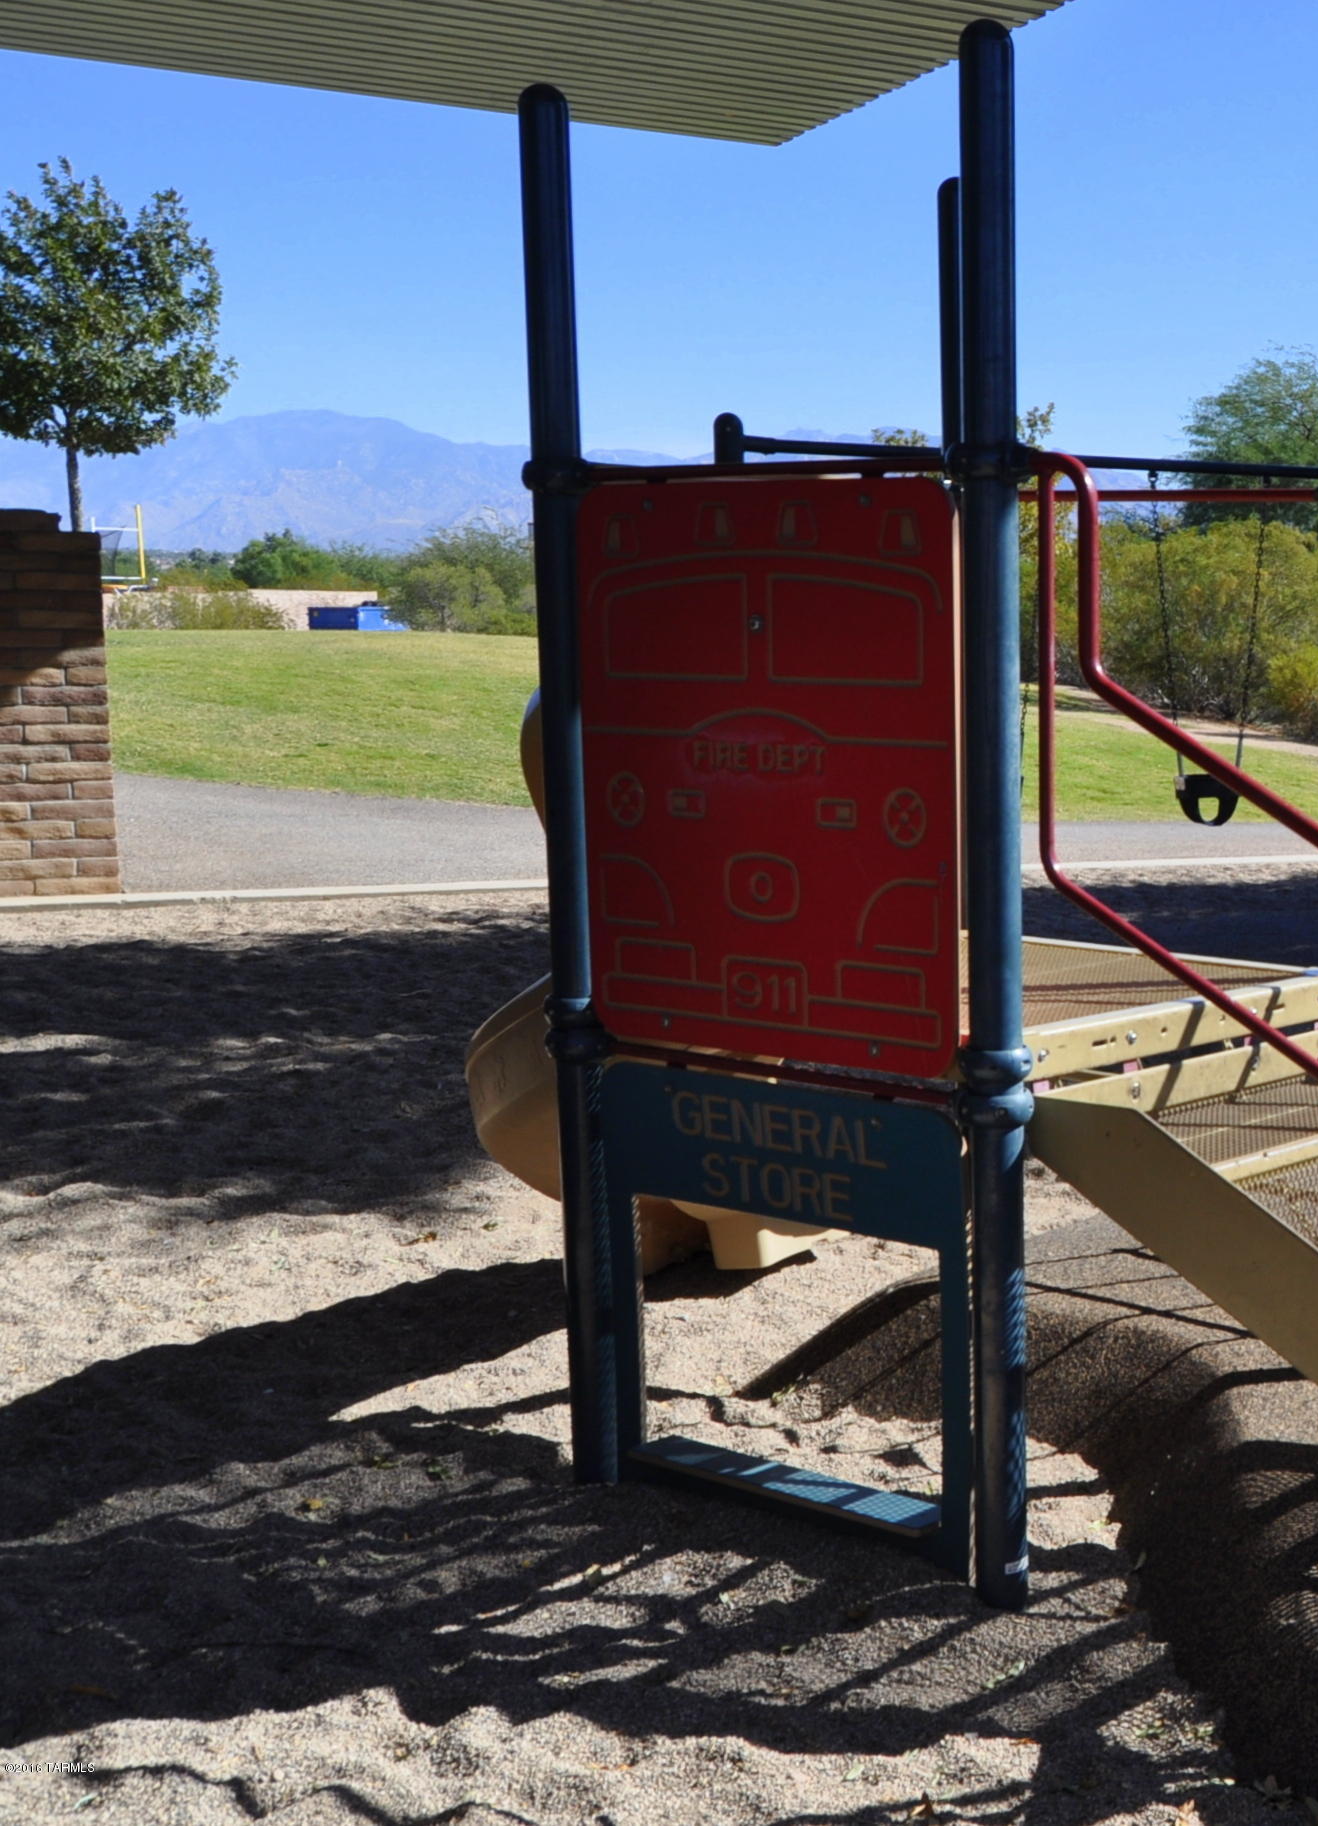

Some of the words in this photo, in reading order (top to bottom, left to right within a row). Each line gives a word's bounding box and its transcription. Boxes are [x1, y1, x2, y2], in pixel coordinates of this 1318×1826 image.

[693, 740, 750, 771] FIRE
[758, 743, 826, 775] DEPT
[732, 971, 796, 1016] 911
[671, 1091, 887, 1169] GENERAL
[702, 1152, 853, 1221] STORE
